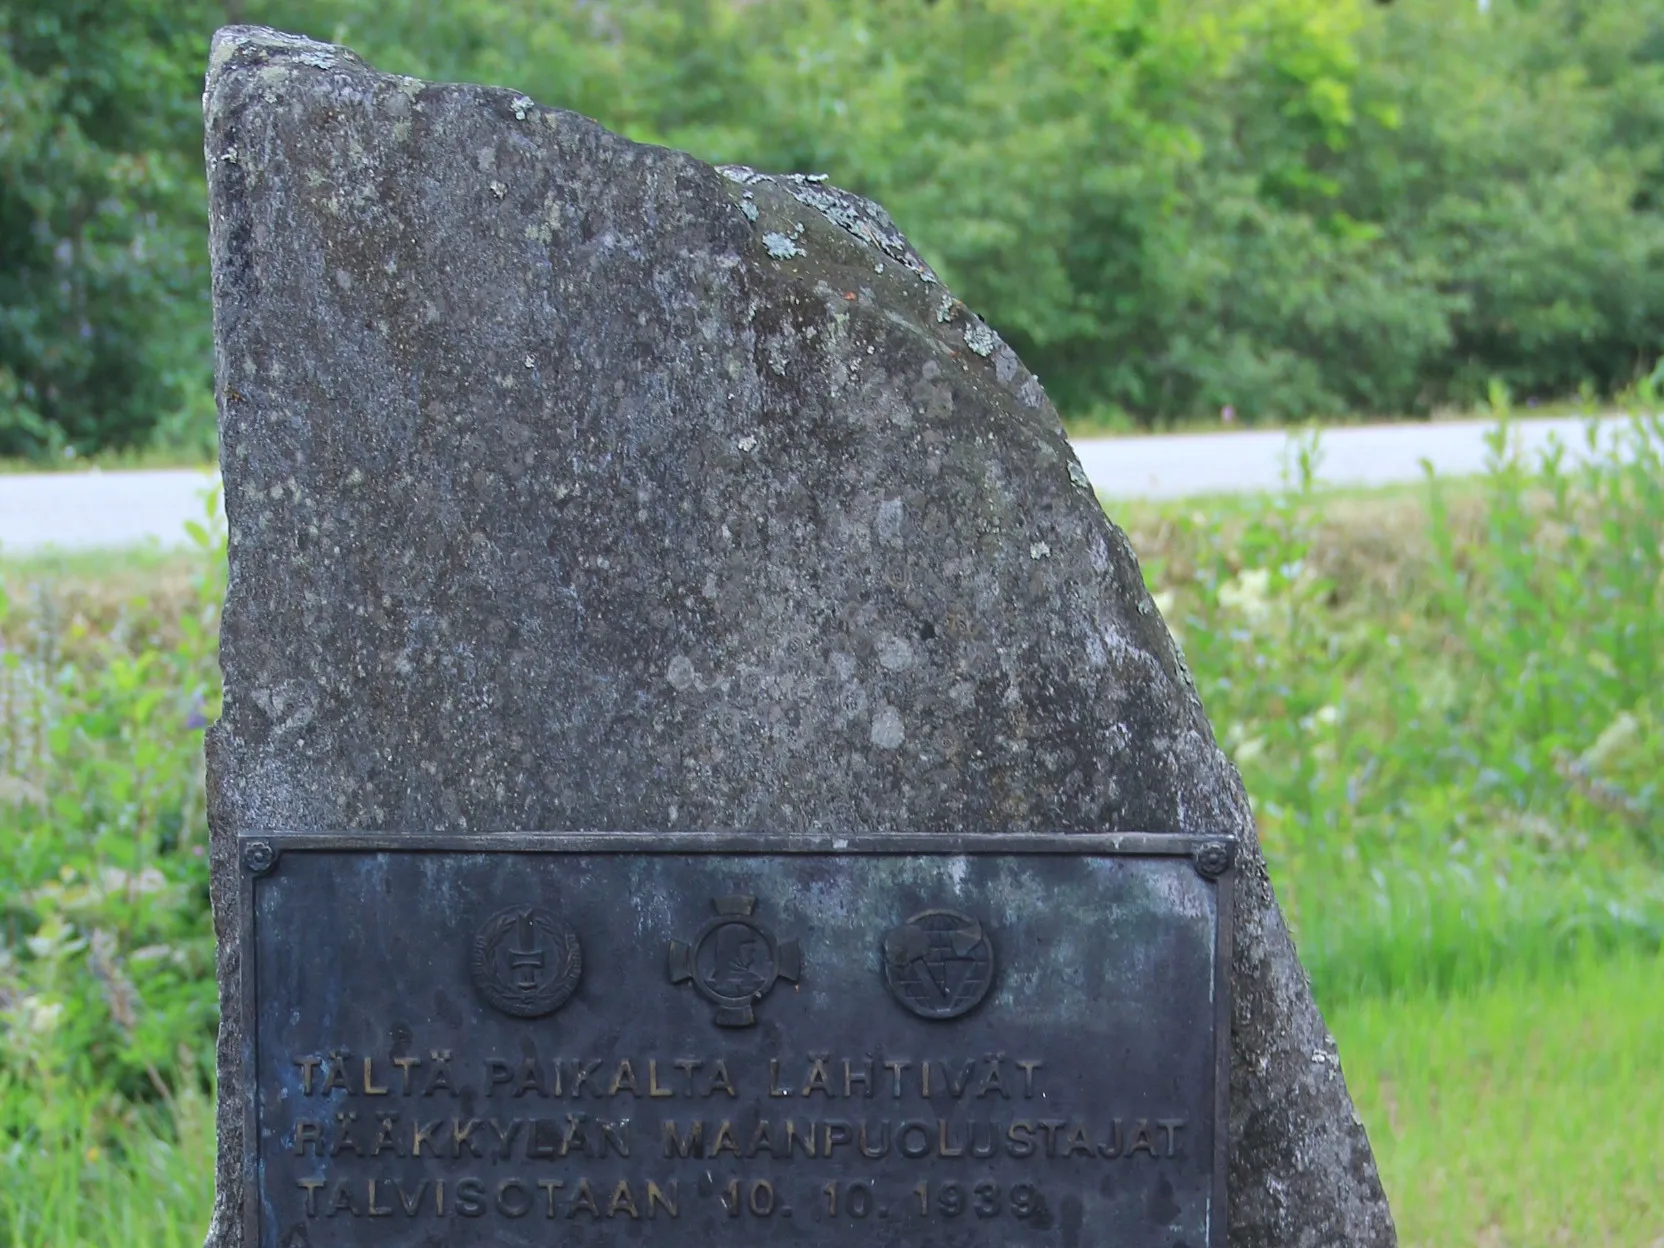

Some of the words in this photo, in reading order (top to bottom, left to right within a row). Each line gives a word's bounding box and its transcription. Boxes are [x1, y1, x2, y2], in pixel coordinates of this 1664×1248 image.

[293, 1050, 457, 1098] TÄLTÄ
[484, 1055, 736, 1098] PAIKALTA
[768, 1050, 1043, 1099] LÄHTIVÄT
[294, 1110, 632, 1158] RÄÄKKYLÄN
[661, 1115, 1186, 1160] MAANPUOLUSTAJAT
[297, 1175, 680, 1219] TALVISOTAAN
[726, 1178, 794, 1219] 10.
[822, 1178, 889, 1219] 10.
[913, 1177, 1036, 1219] 1939
